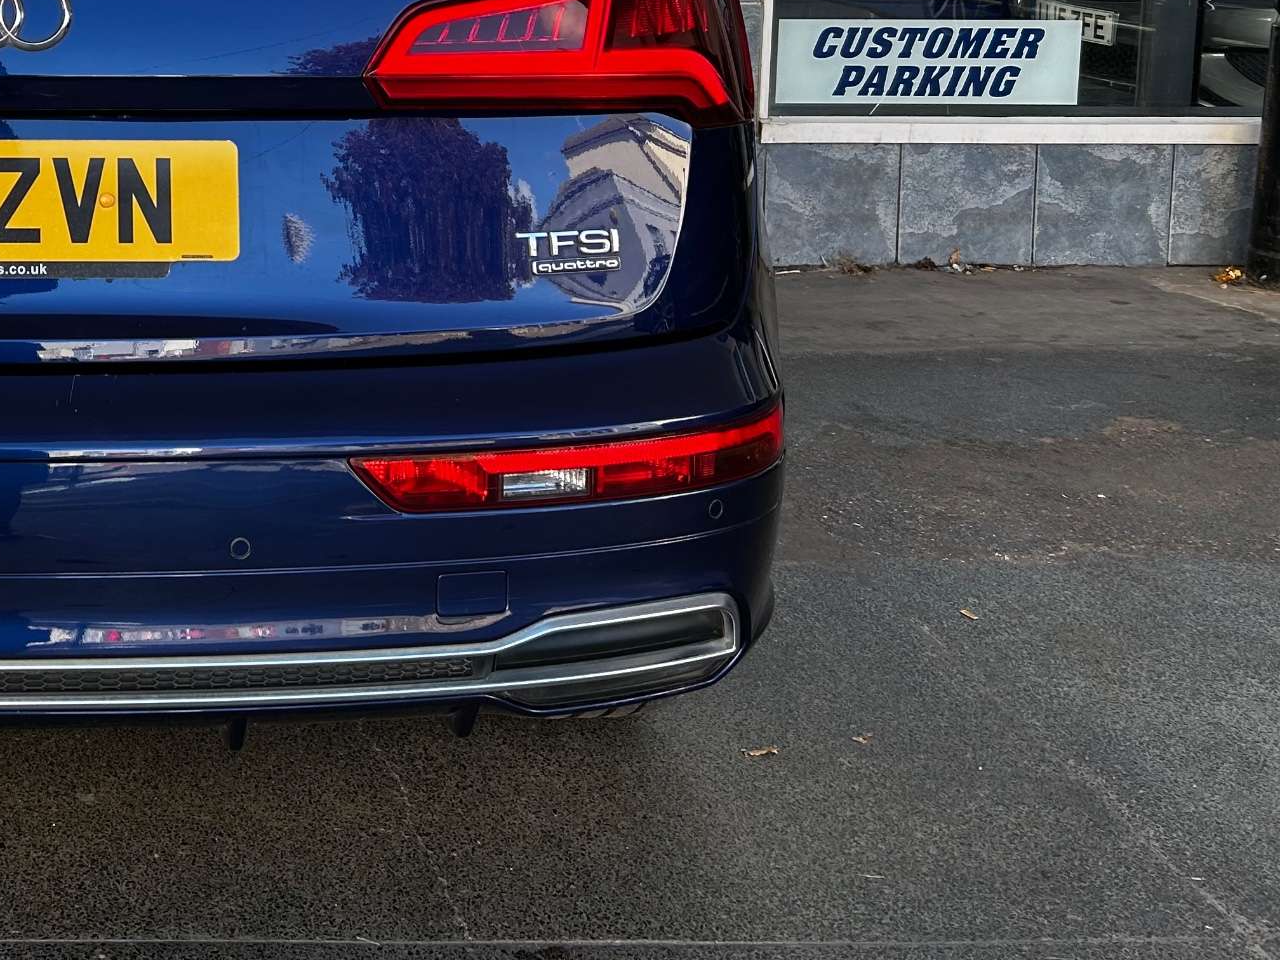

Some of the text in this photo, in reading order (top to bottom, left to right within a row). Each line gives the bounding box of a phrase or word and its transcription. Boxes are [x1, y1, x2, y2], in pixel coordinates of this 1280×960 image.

[812, 26, 1046, 59] CUSTOMER
[832, 65, 1021, 98] PARKING
[515, 228, 620, 257] TFSI
[538, 258, 619, 273] quattro
